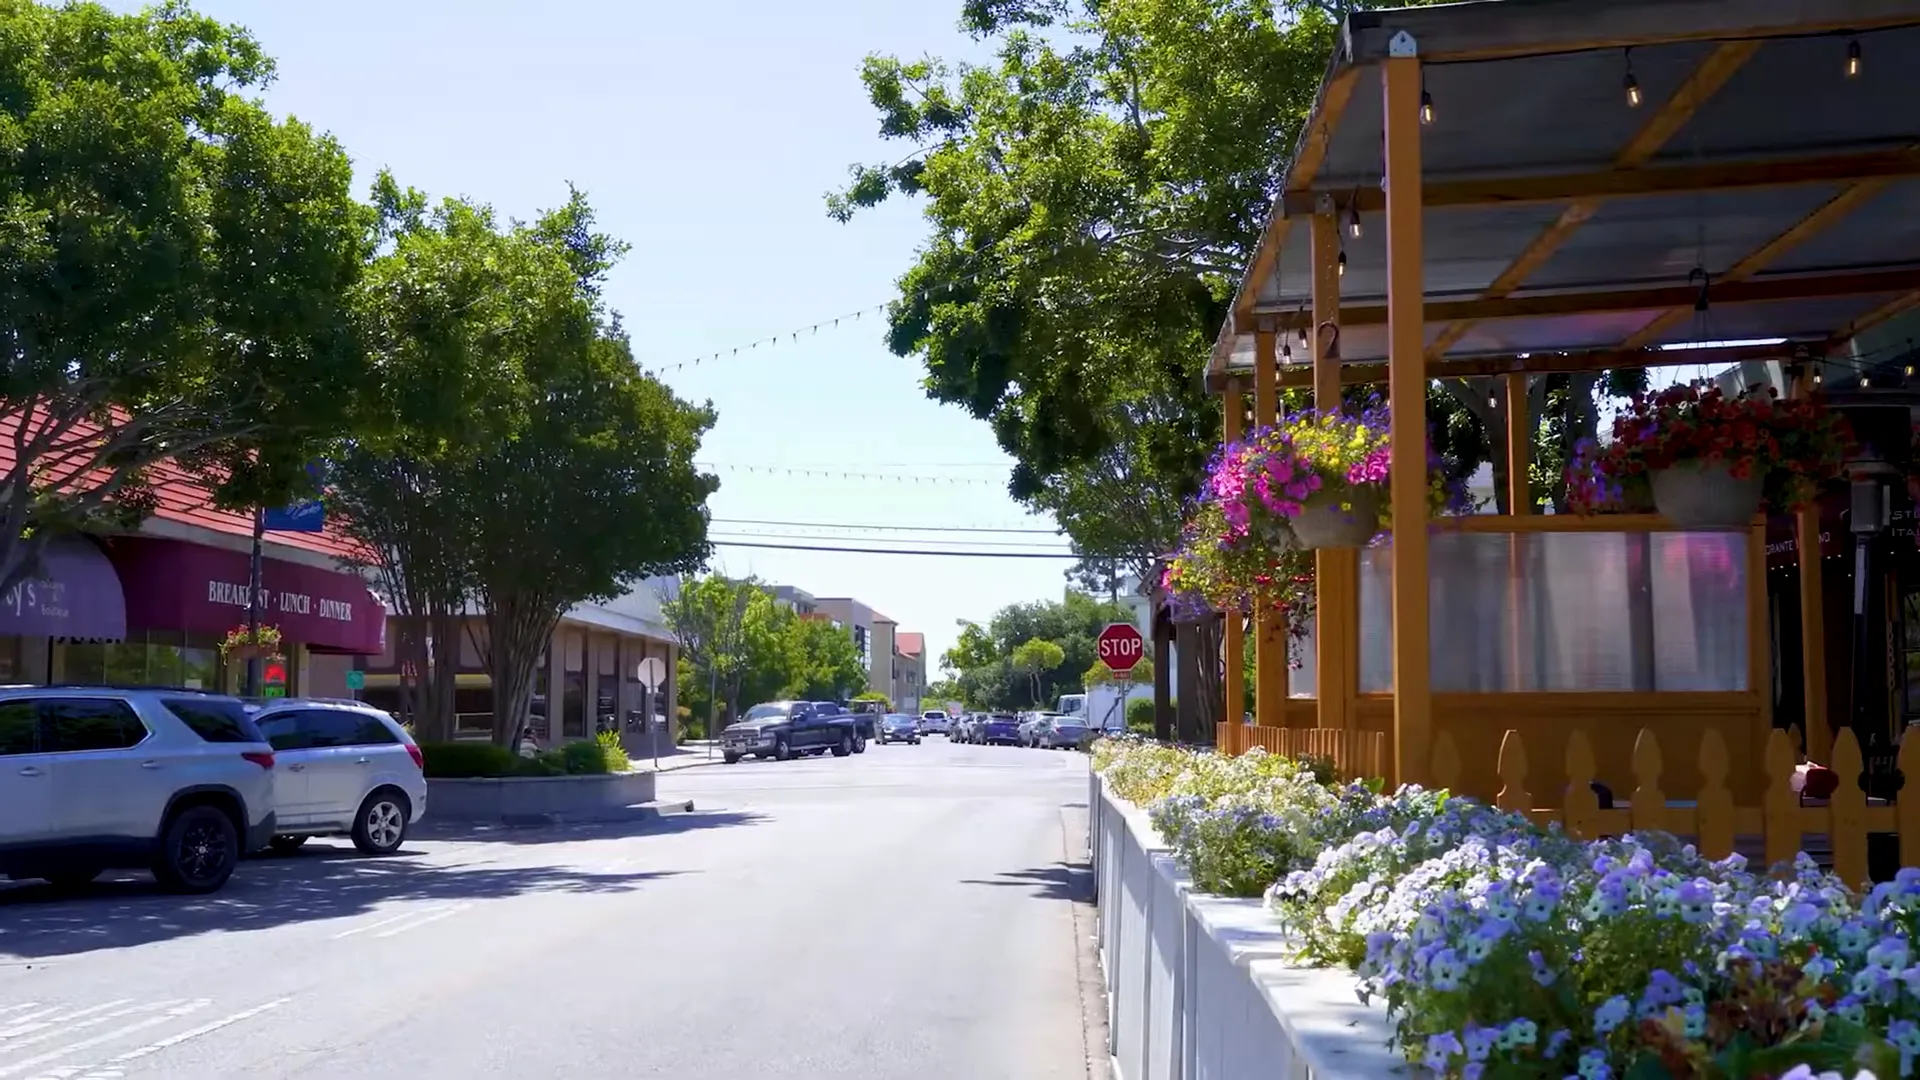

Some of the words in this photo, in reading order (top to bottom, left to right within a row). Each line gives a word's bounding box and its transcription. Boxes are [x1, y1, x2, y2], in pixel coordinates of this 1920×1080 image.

[208, 581, 270, 610] BREAKFST
[279, 592, 311, 615] LUNCH
[319, 598, 352, 621] DINNER
[1100, 638, 1141, 657] STOP
